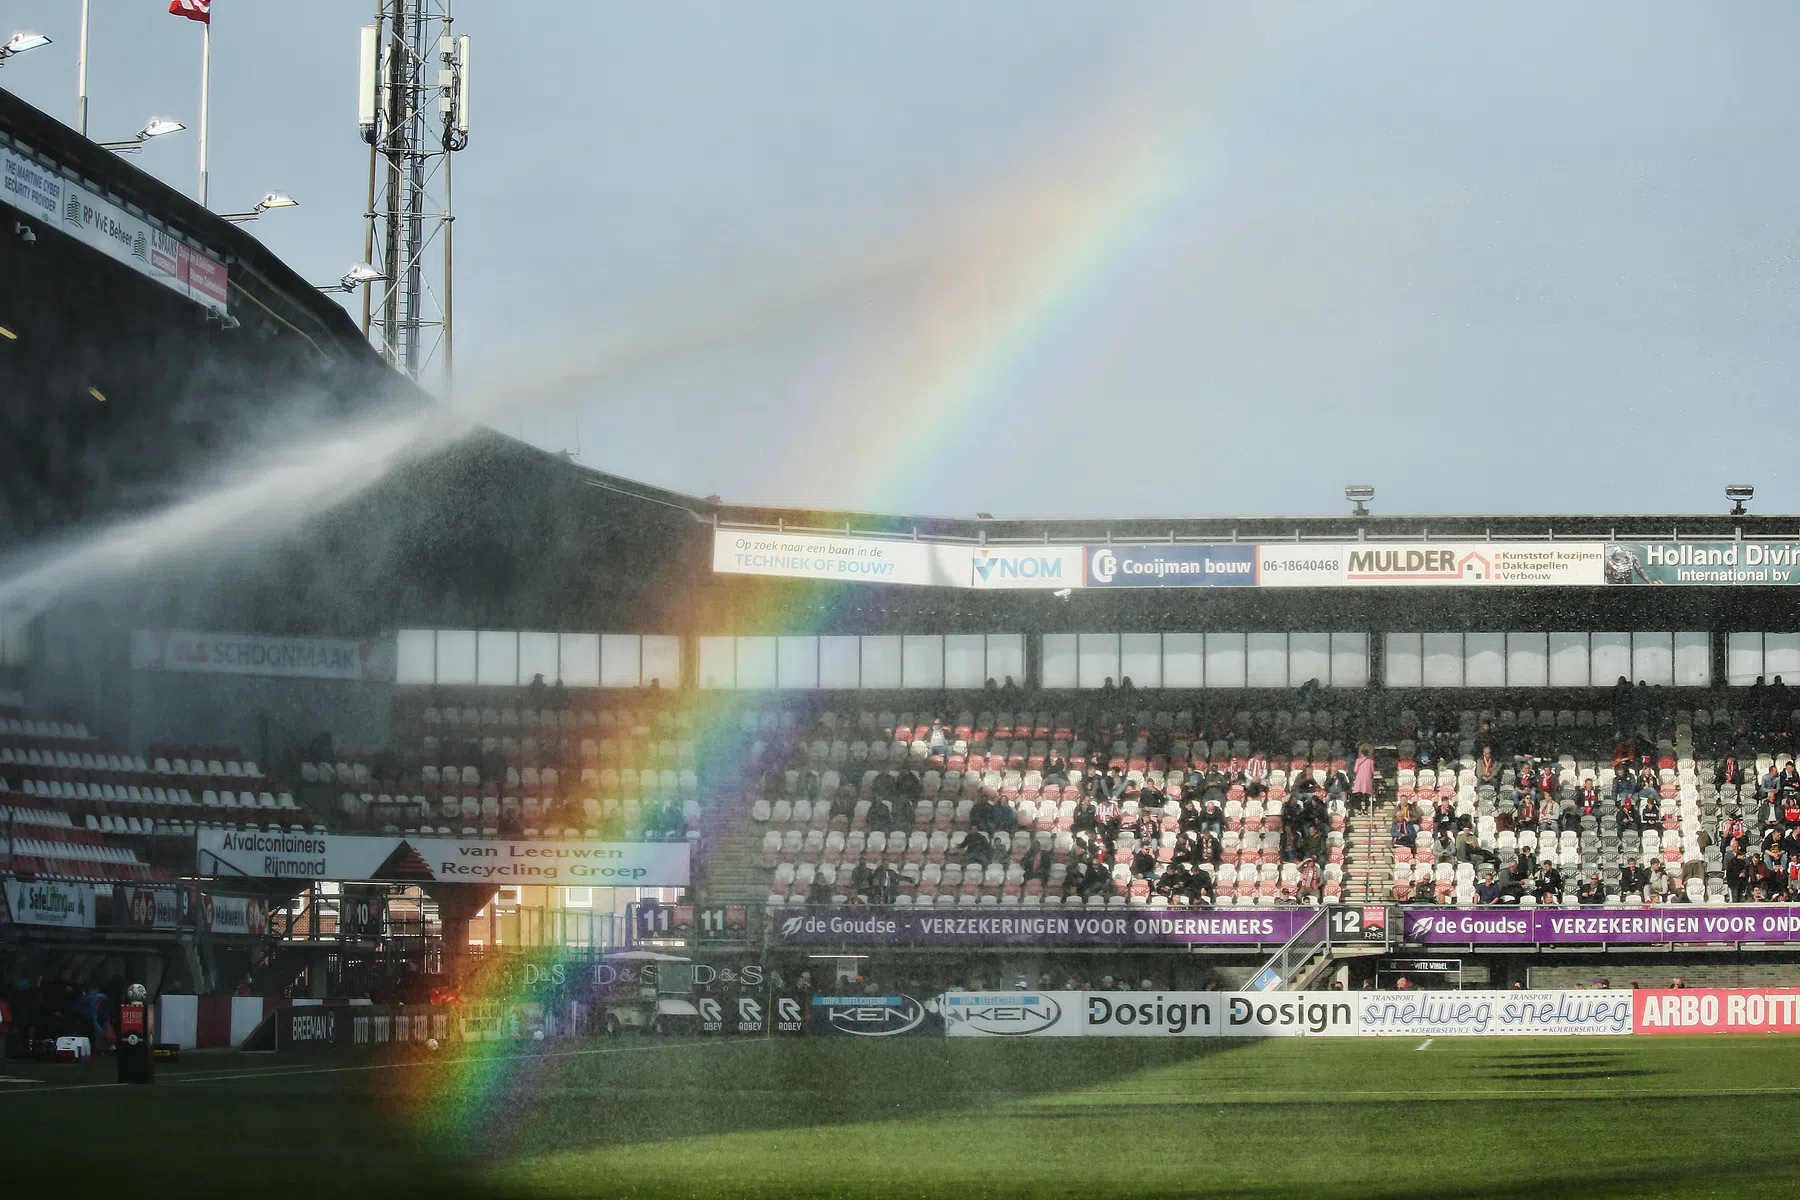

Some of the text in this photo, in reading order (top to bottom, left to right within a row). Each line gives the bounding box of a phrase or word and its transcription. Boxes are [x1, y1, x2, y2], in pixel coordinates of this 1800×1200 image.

[5, 159, 60, 199] THE MARITIME CYBER
[4, 176, 56, 213] SECURITY PROVIDER
[83, 205, 133, 247] RP VvE Beheer
[736, 538, 883, 558] Op zoek naar een baan in de
[1502, 550, 1603, 562] Kunststof kozijnen
[1647, 544, 1739, 566] Holland
[735, 553, 895, 575] TECHNIEK OF BOUW?
[1000, 557, 1062, 578] NOM
[1122, 559, 1252, 577] Cooijman bouw
[1263, 560, 1339, 572] 06-18640468
[1348, 550, 1456, 572] MULDER
[1502, 561, 1568, 571] Dakkapellen
[1502, 571, 1551, 580] Verbouw
[1677, 569, 1791, 581] International bv
[215, 643, 355, 669] SCHOONMAAK
[223, 832, 326, 854] Afvalcontainers
[458, 845, 624, 859] van Leeuwen
[264, 856, 326, 877] Rijnmond
[440, 862, 648, 879] Recycling Groep
[183, 891, 188, 916] 9
[357, 903, 369, 925] 10
[215, 904, 245, 926] Hekwerk
[643, 909, 669, 931] 11
[701, 909, 724, 931] 11
[806, 916, 826, 933] de
[831, 916, 897, 933] Goudse
[921, 918, 1069, 934] VERZEKERINGEN
[1074, 918, 1127, 934] VOOR
[1134, 919, 1274, 935] ONDERNEMERS
[1332, 910, 1360, 933] 12
[1435, 916, 1457, 934] de
[1460, 916, 1527, 934] Goudse
[1551, 918, 1699, 934] VERZEKERINGEN
[1704, 917, 1755, 933] VOOR
[522, 964, 566, 985] D&S
[592, 964, 658, 985] D&S
[691, 964, 764, 985] D&S
[1371, 994, 1416, 1002] TRANSPORT
[1509, 993, 1554, 1001] TRANSPORT
[829, 1007, 914, 1021] KEN
[966, 1007, 1051, 1021] KEN
[1089, 996, 1212, 1033] Dosign
[1229, 996, 1352, 1033] Dosign
[1641, 994, 1719, 1027] ARBO
[292, 1015, 327, 1041] BREEMAN
[703, 1022, 723, 1031] OBEY
[738, 1022, 762, 1031] ROBEY
[778, 1022, 802, 1031] ROBEY
[1410, 1026, 1470, 1035] KOERIERSERVICE
[1548, 1025, 1608, 1034] KOERIERSERVICE
